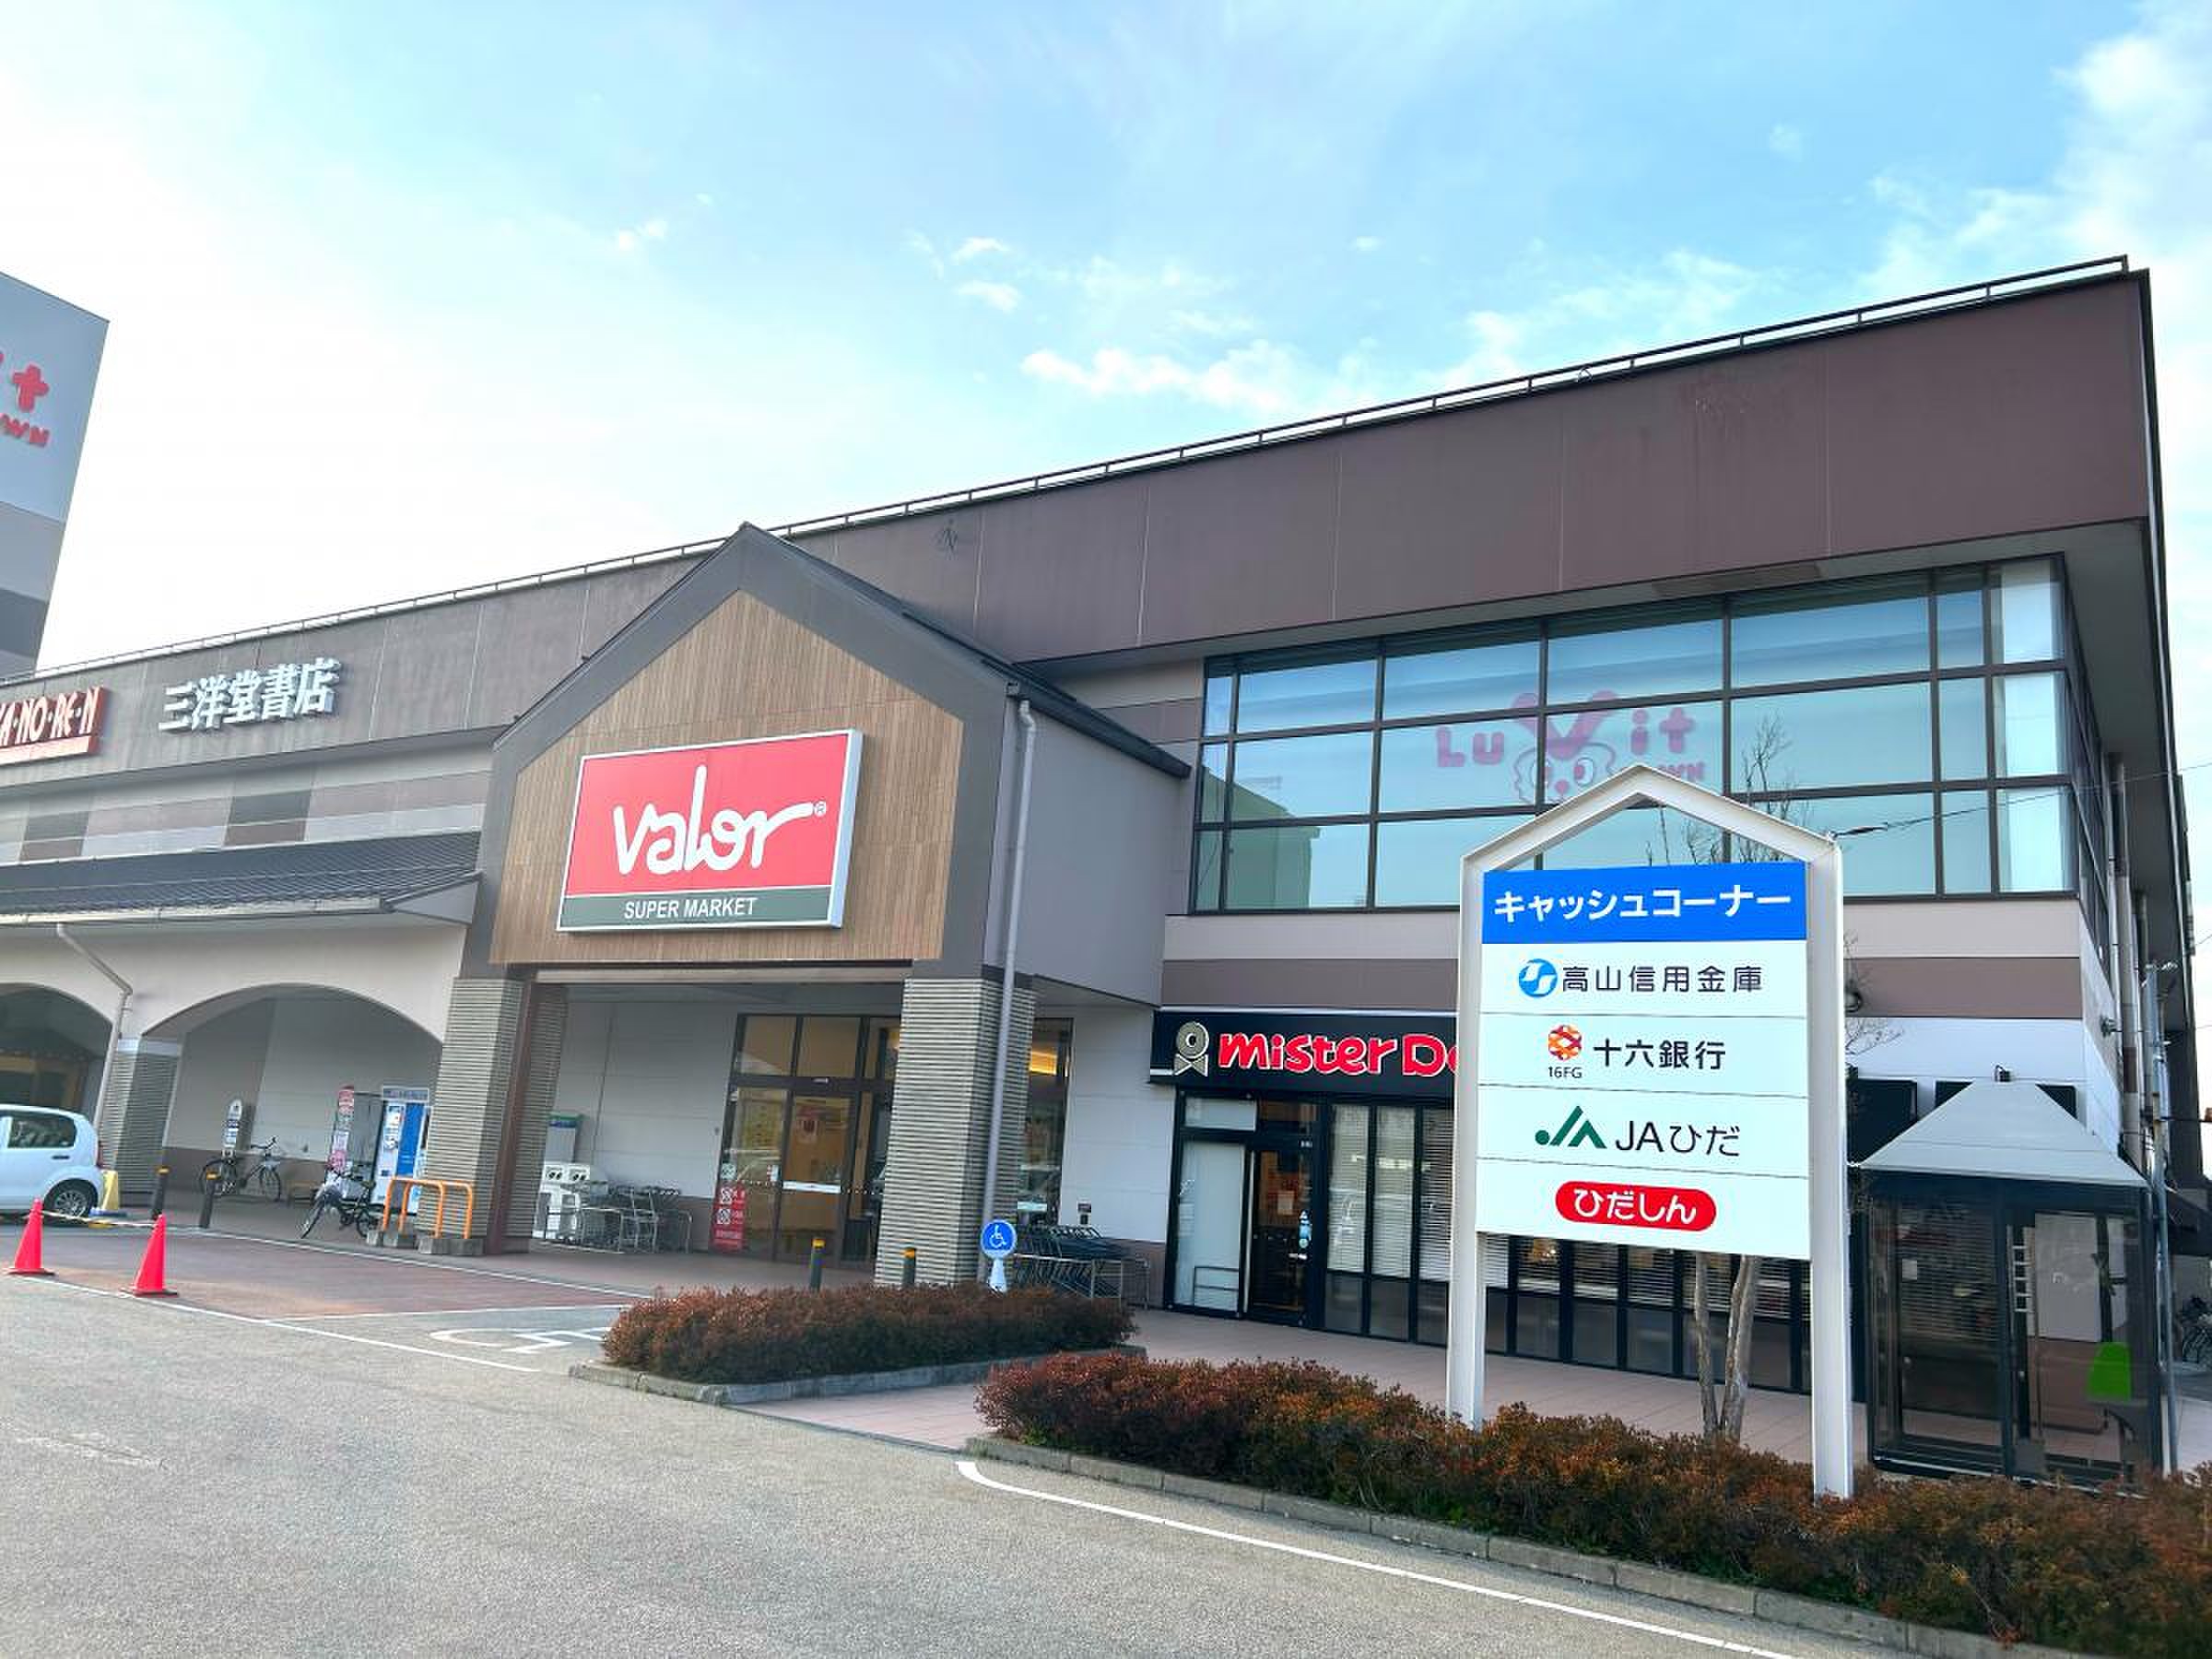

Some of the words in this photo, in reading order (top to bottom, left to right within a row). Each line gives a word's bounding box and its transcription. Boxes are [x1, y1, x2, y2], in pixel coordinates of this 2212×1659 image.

[159, 658, 342, 732] 三洋堂書店
[624, 900, 679, 919] SUPER
[684, 898, 758, 918] MARKET
[1494, 885, 1791, 922] キャッシュコーナー
[1562, 966, 1762, 993] 高山信用金庫
[1401, 1033, 1458, 1077] D
[1548, 1066, 1583, 1078] 16FG
[1593, 1039, 1726, 1070] 十六銀行
[1615, 1121, 1741, 1157] JAひだ
[1572, 1187, 1698, 1224] ひだしん
